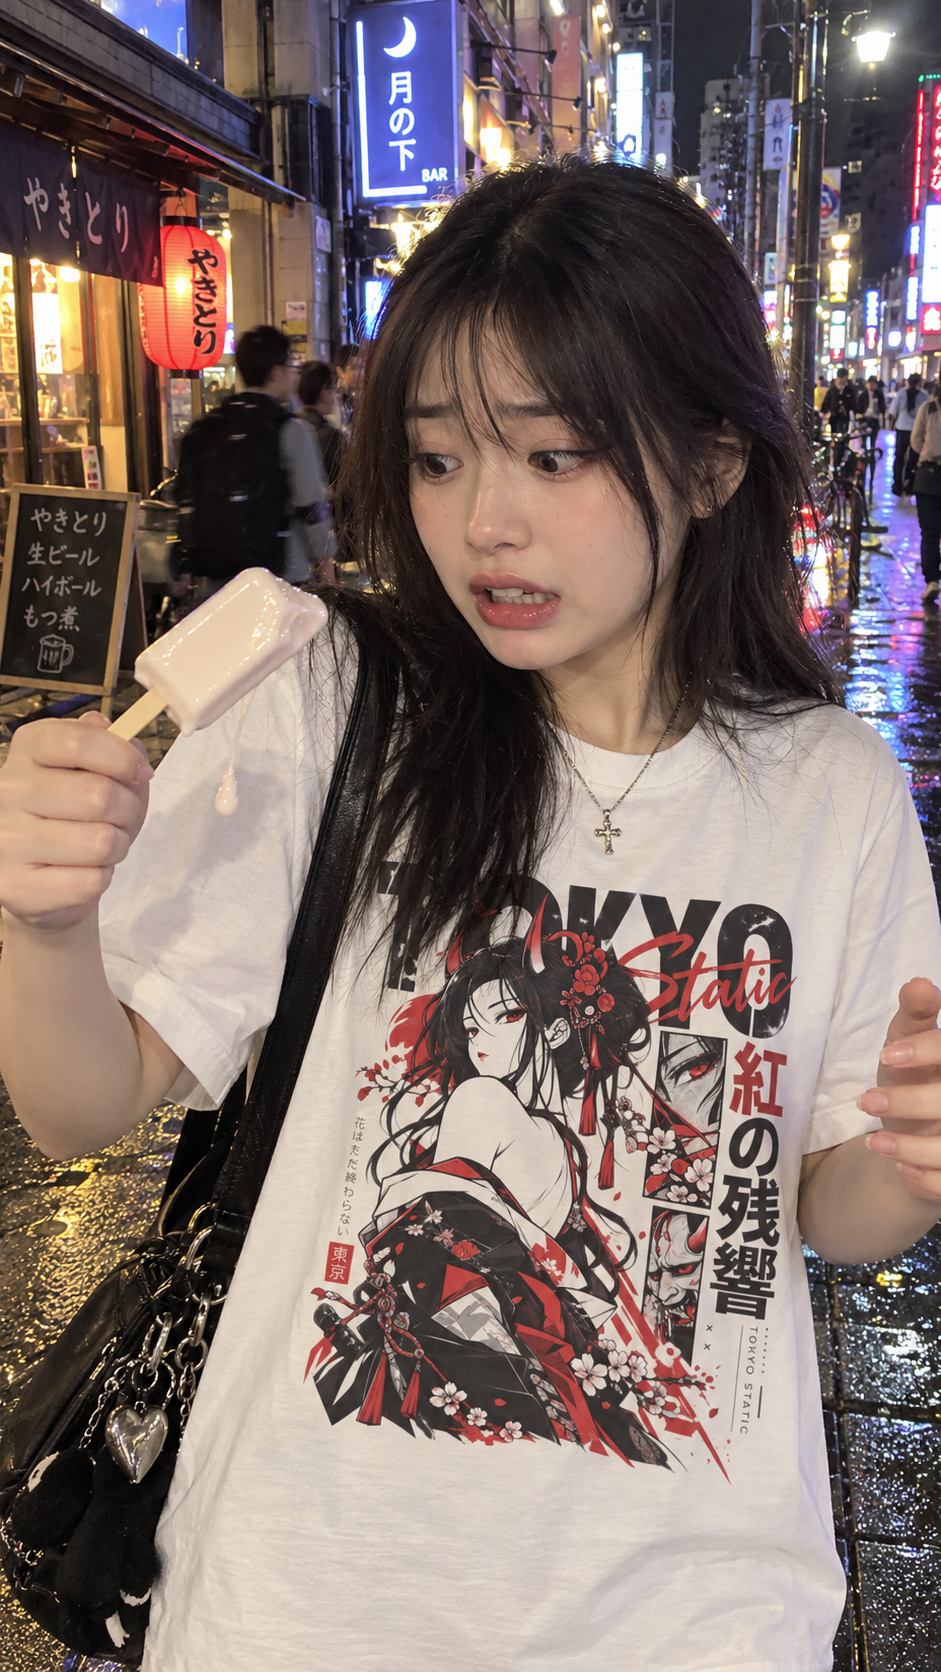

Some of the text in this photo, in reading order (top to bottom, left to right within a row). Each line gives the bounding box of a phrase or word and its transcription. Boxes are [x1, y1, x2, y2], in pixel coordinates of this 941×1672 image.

[388, 71, 417, 171] 月の下
[421, 167, 448, 183] BAR
[23, 177, 129, 252] やきとり
[187, 248, 219, 355] やきとり
[26, 542, 100, 566] 生ビール
[30, 508, 107, 537] やきとり
[21, 575, 102, 597] ハイボール
[23, 604, 80, 632] もつ煮
[618, 931, 798, 1024] Static
[338, 1117, 366, 1236] 花はただ終わらない
[709, 1041, 788, 1320] 紅の残響
[328, 1246, 349, 1281] 東京
[740, 1326, 758, 1434] TOKYO STATIC
